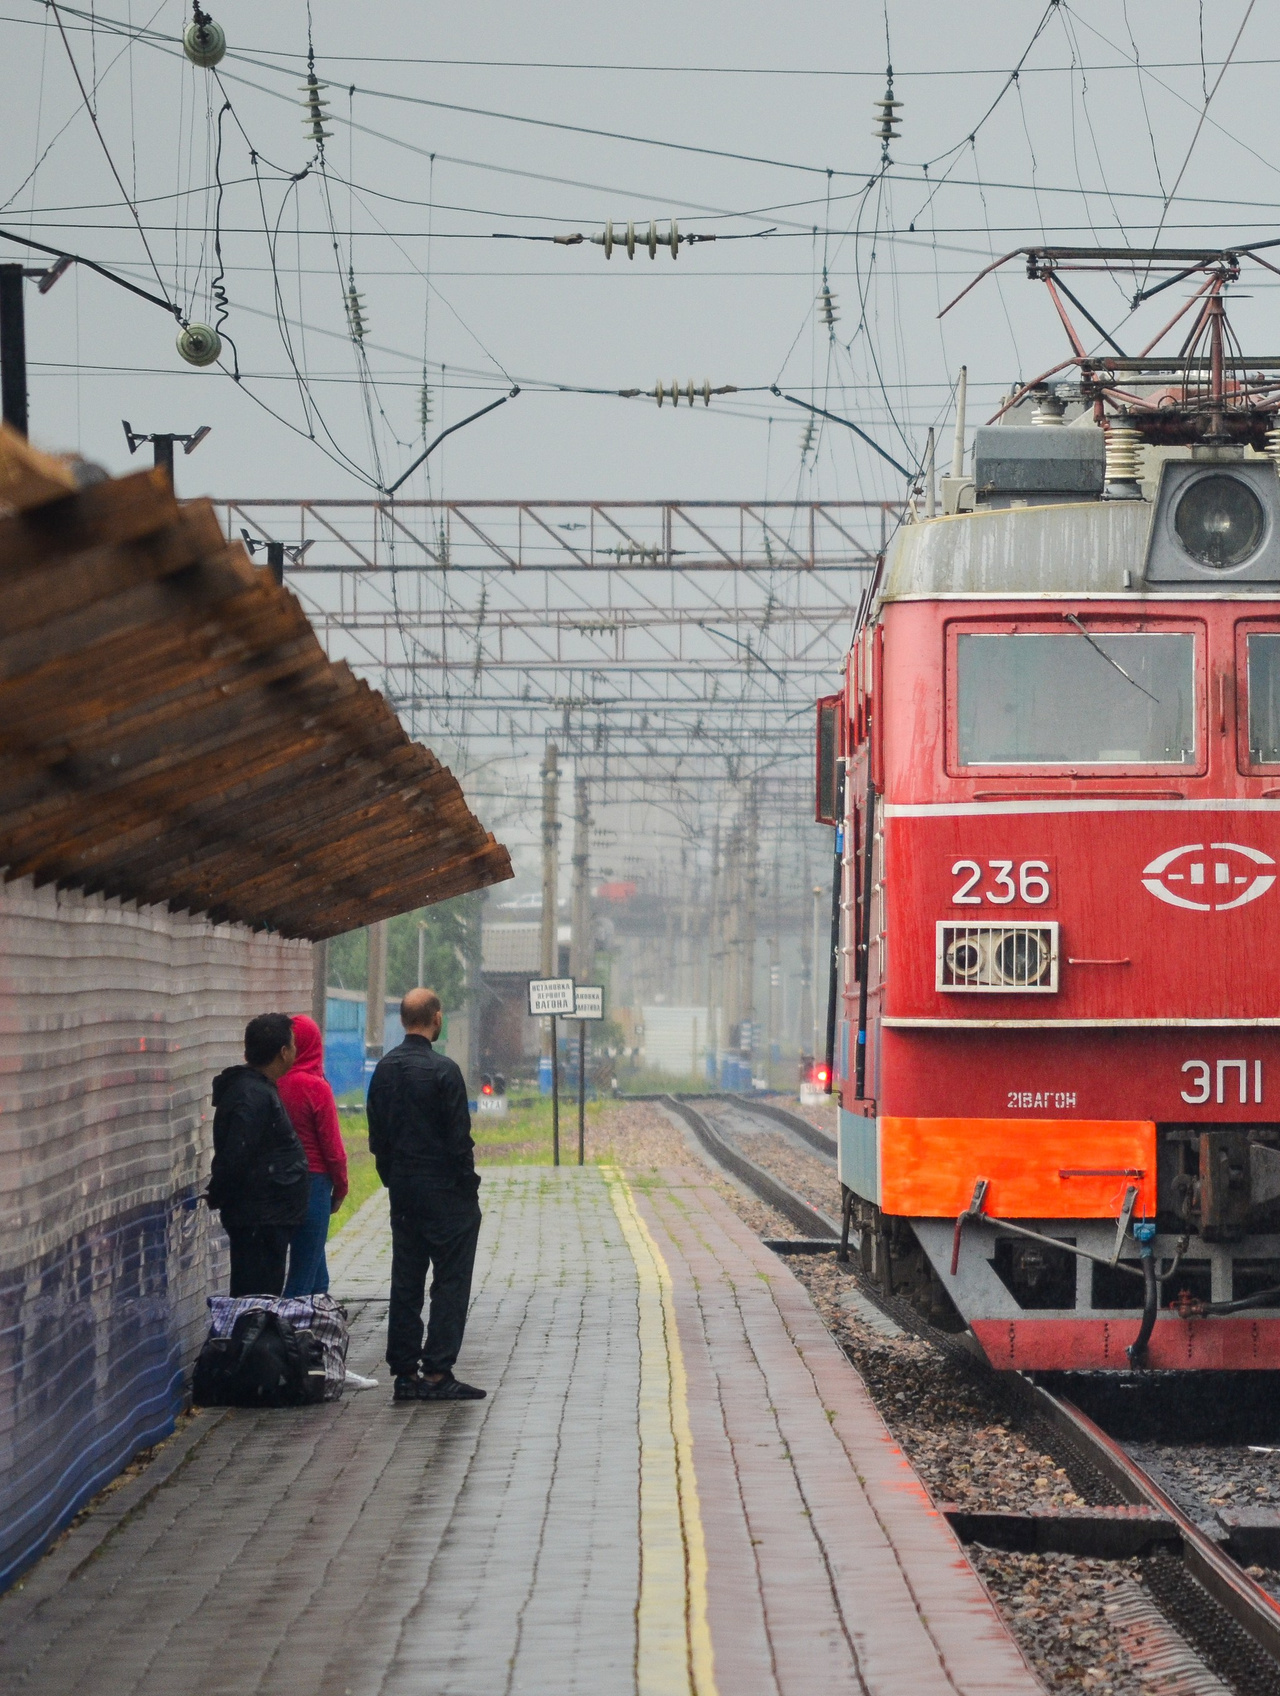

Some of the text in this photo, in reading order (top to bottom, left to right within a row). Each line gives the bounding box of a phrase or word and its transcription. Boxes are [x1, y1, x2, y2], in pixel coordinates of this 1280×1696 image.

[951, 860, 1050, 904] 236
[535, 999, 568, 1010] ВАГОНА
[1181, 1060, 1262, 1104] ЭП1
